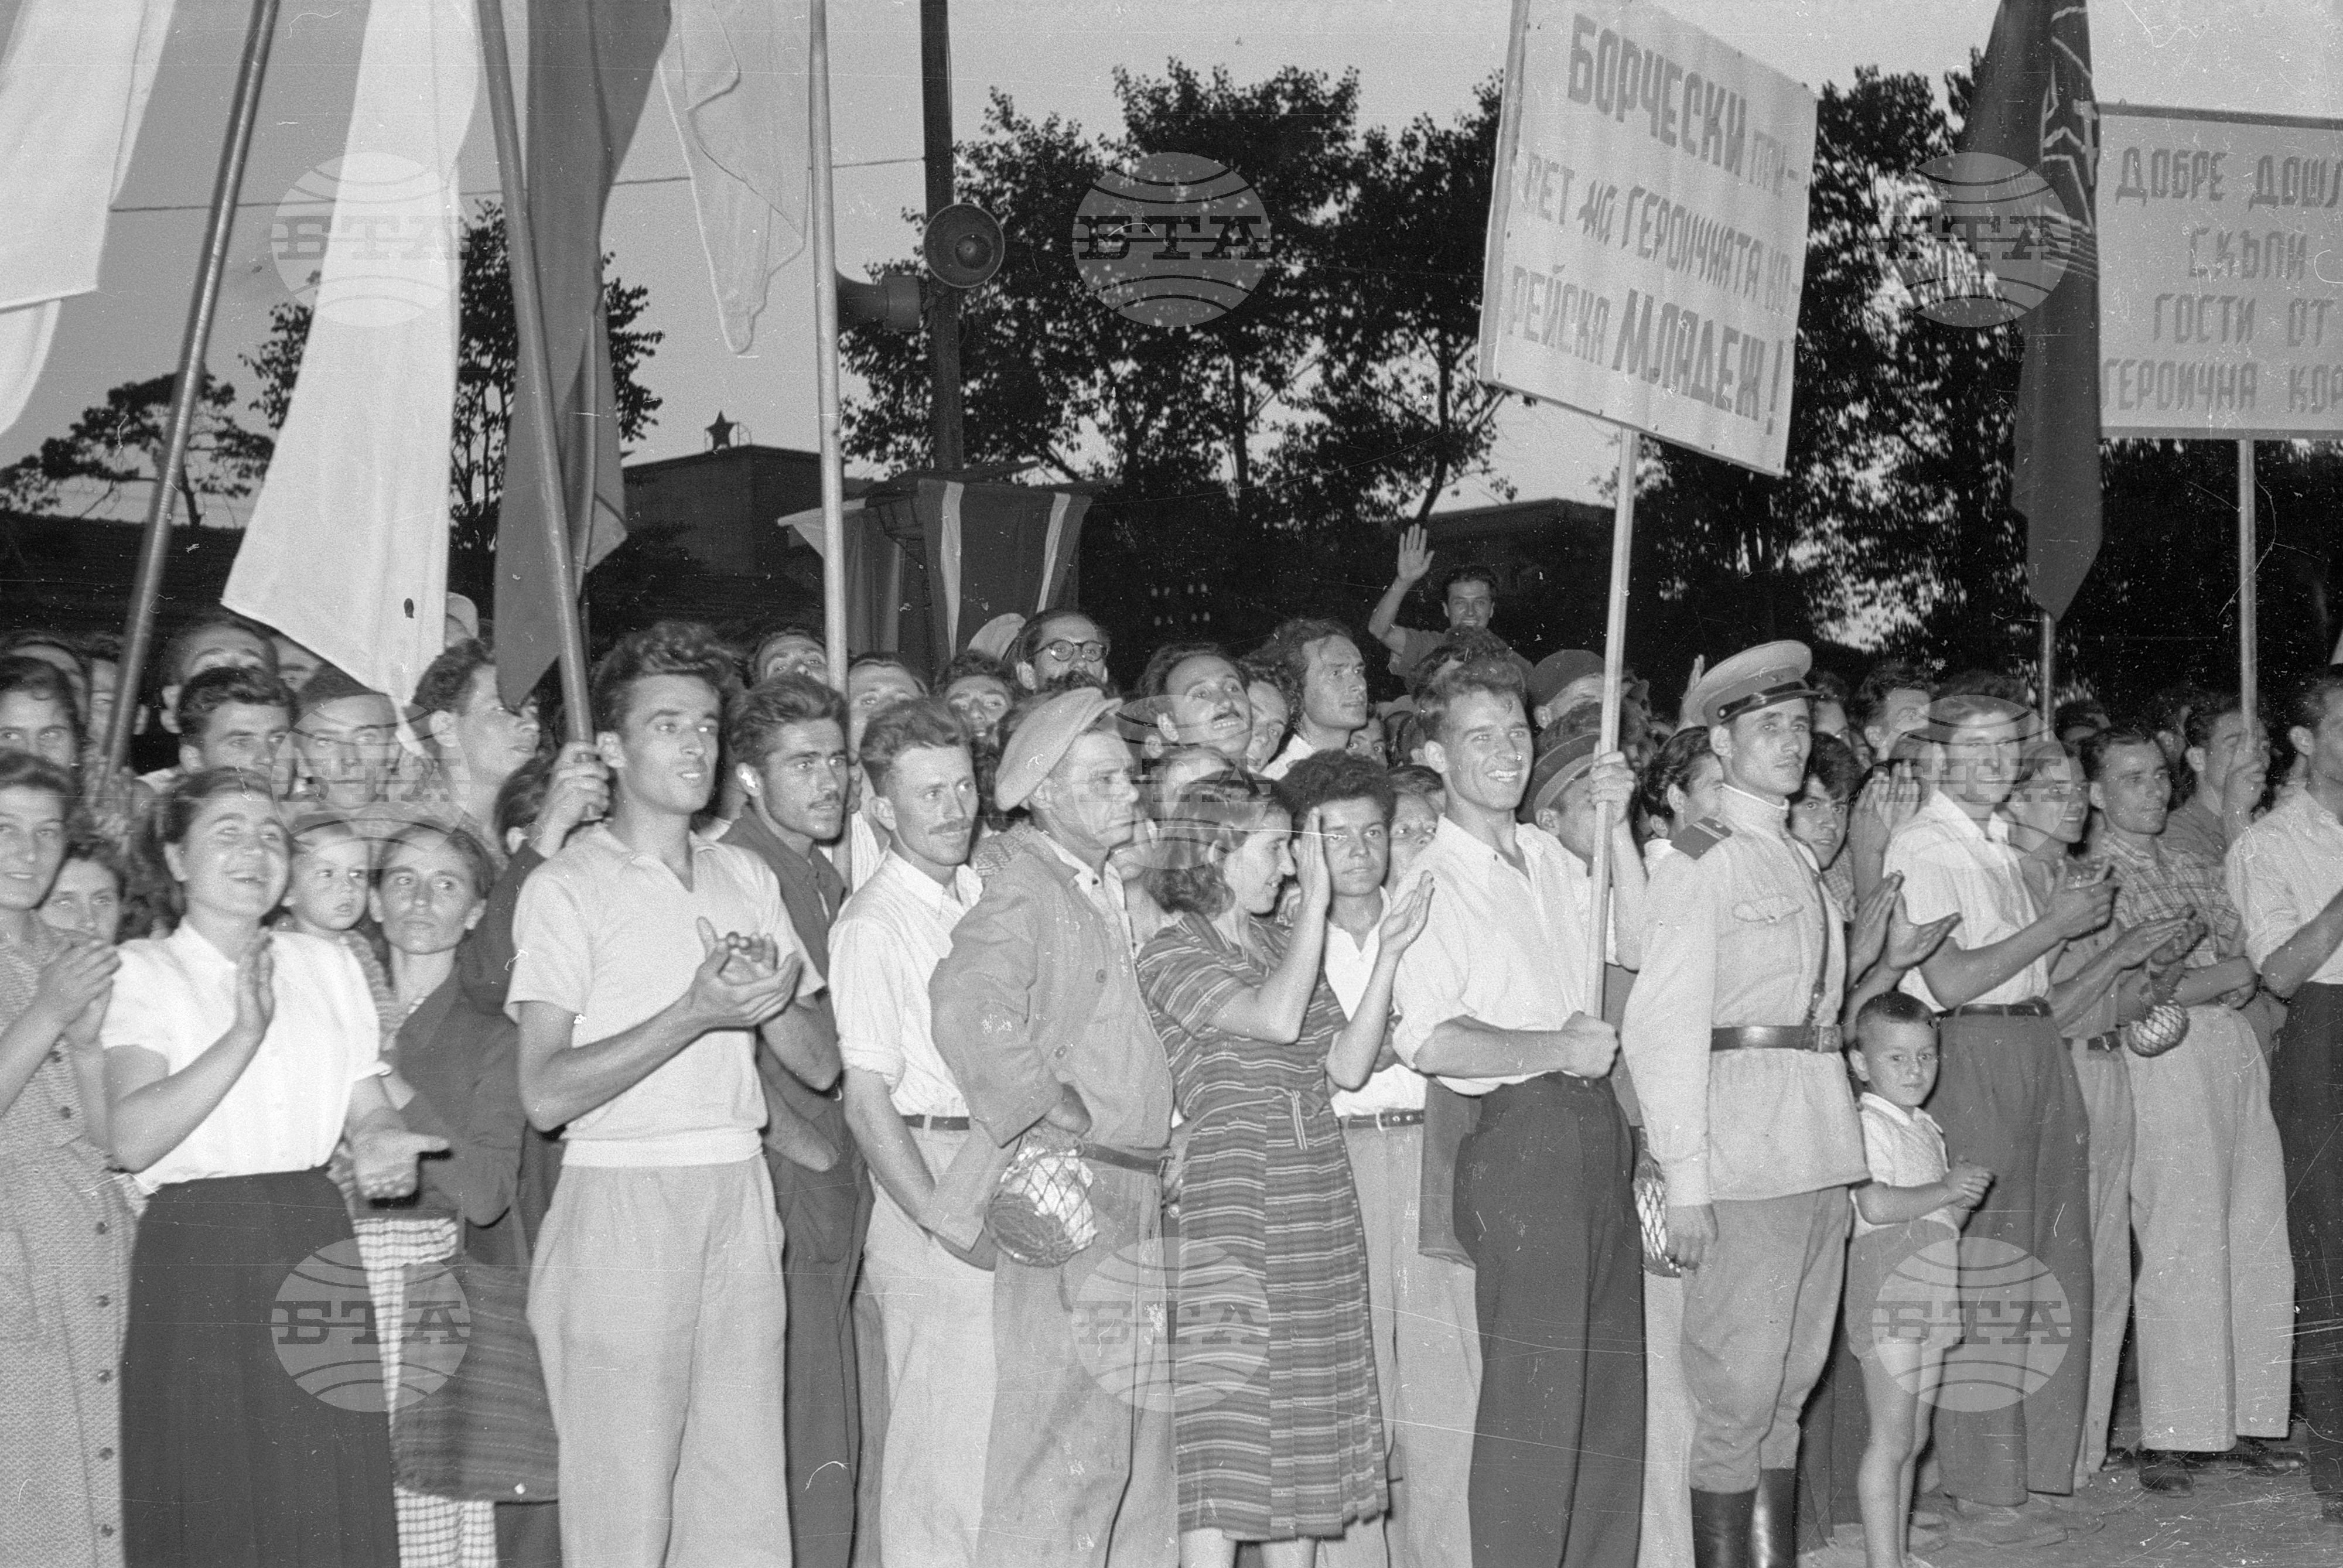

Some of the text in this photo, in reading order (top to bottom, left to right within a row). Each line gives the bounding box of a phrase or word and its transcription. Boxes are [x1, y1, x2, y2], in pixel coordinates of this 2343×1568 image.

[1568, 13, 1747, 176] БОРЧЕСКИ
[2115, 146, 2227, 206] ДОБРЕ
[1577, 180, 1617, 245] НА
[1621, 185, 1763, 303] ГЕРОИЧНАТА
[2189, 227, 2307, 279] СКЪПИ
[1508, 264, 1784, 435] РЕЙСКА МЛАДЕЖ!
[2153, 292, 2334, 347] ГОСТИ ОТ
[2102, 358, 2259, 411] ГЕРОИЧНА
